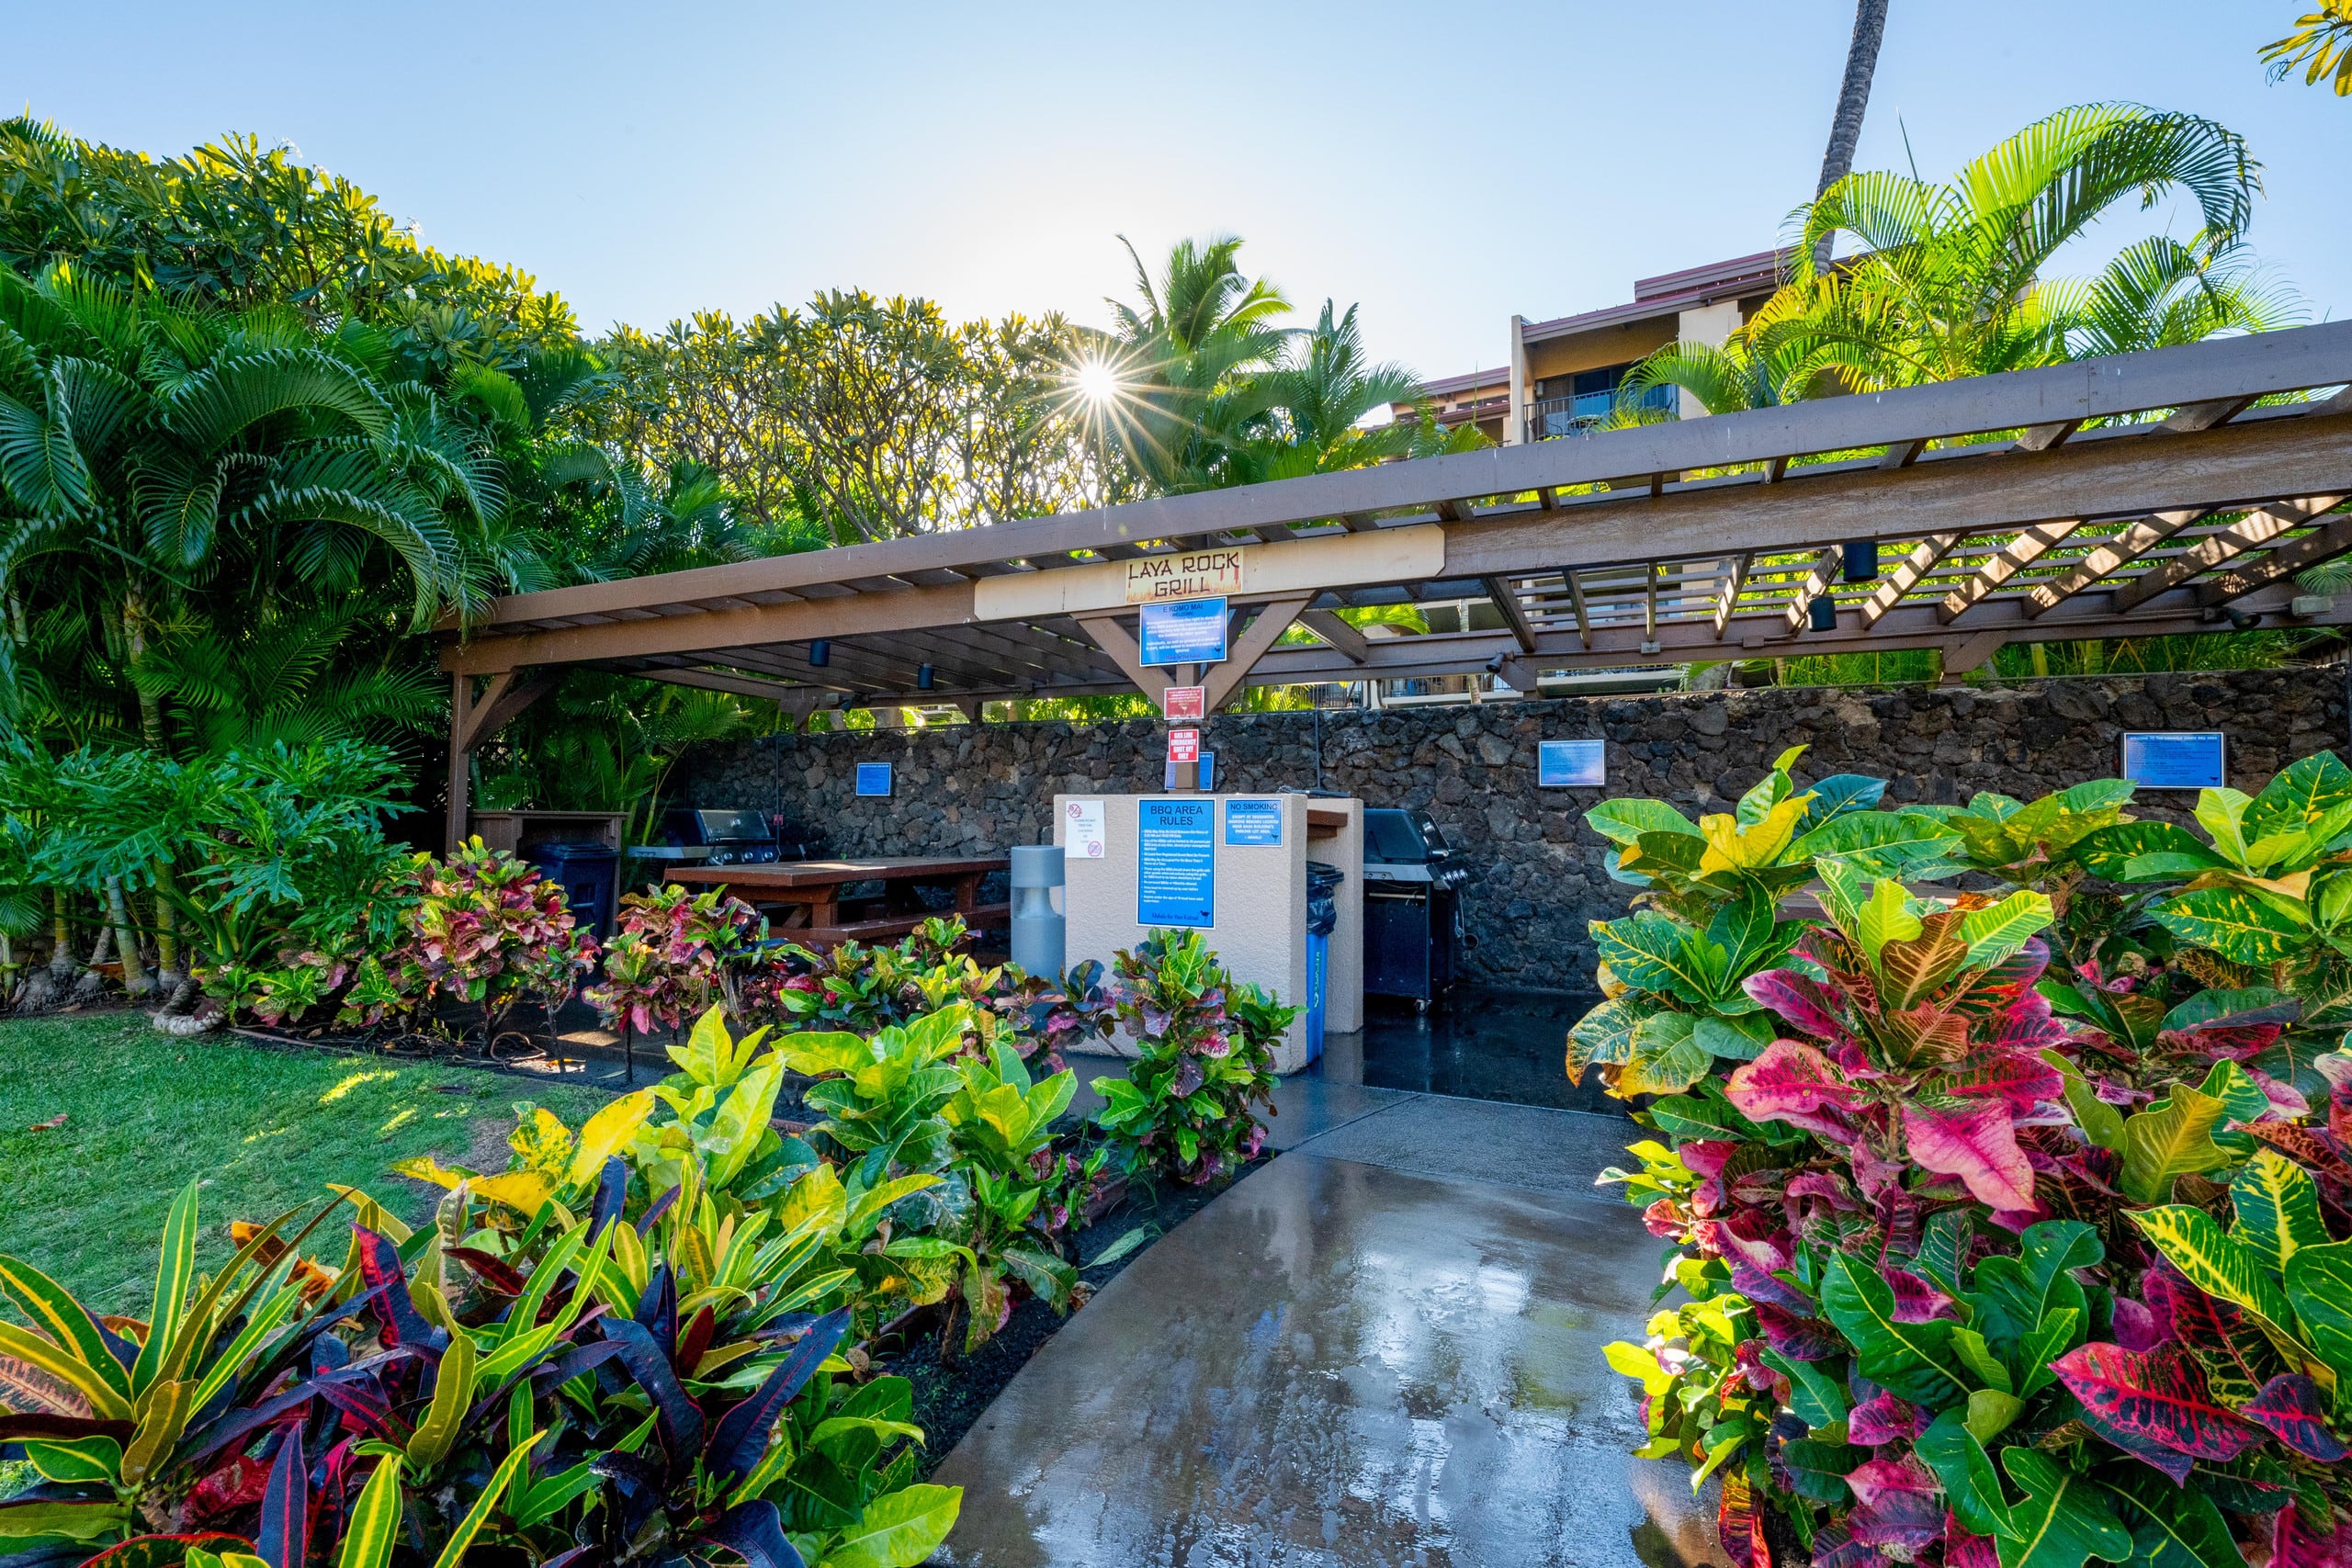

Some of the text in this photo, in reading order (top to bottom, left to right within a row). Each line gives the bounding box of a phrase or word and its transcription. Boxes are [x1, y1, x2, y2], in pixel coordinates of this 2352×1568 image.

[1182, 551, 1239, 573] ROCK
[1154, 577, 1210, 597] GRILL
[1150, 806, 1203, 815] BBQ AREA
[1159, 816, 1193, 826] RULES
